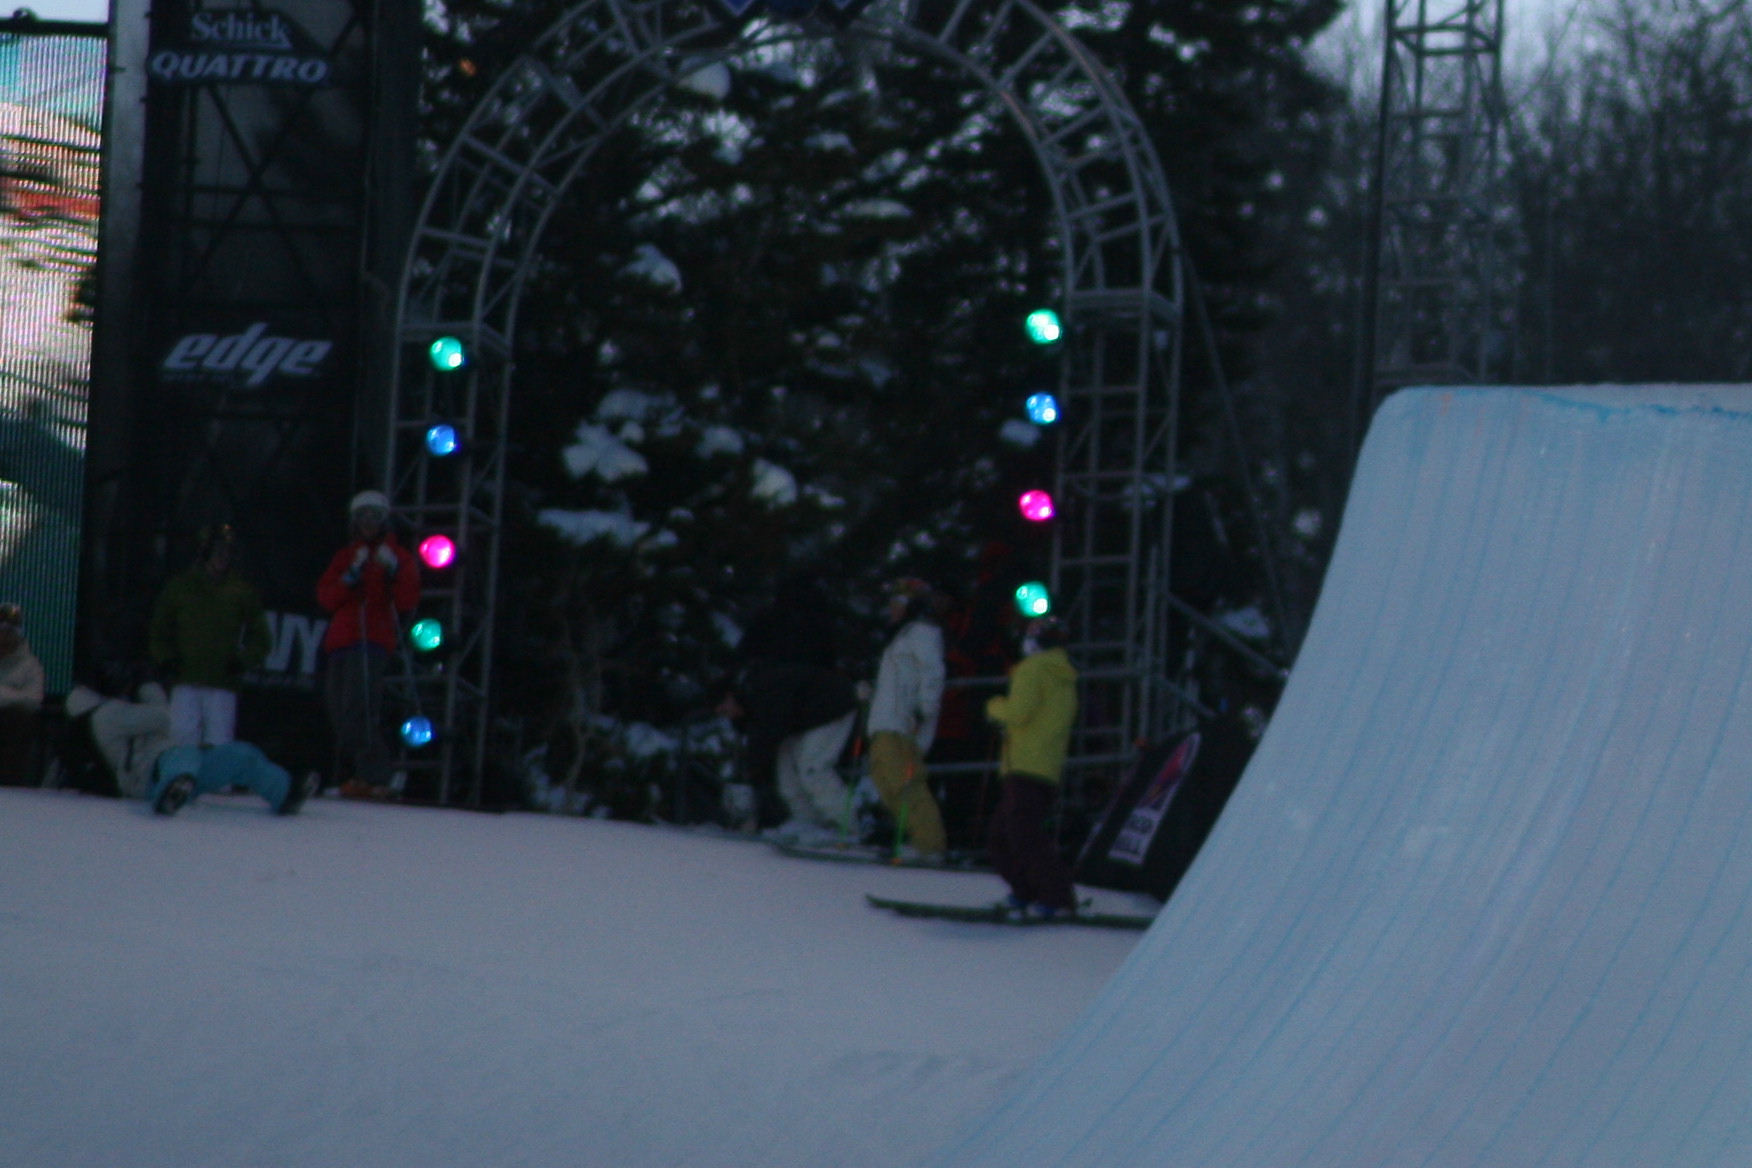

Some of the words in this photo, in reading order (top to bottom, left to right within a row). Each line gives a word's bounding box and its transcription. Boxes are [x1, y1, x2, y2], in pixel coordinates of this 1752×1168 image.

[191, 11, 292, 49] Schick
[151, 51, 331, 82] QUATTRO
[162, 322, 333, 388] edge
